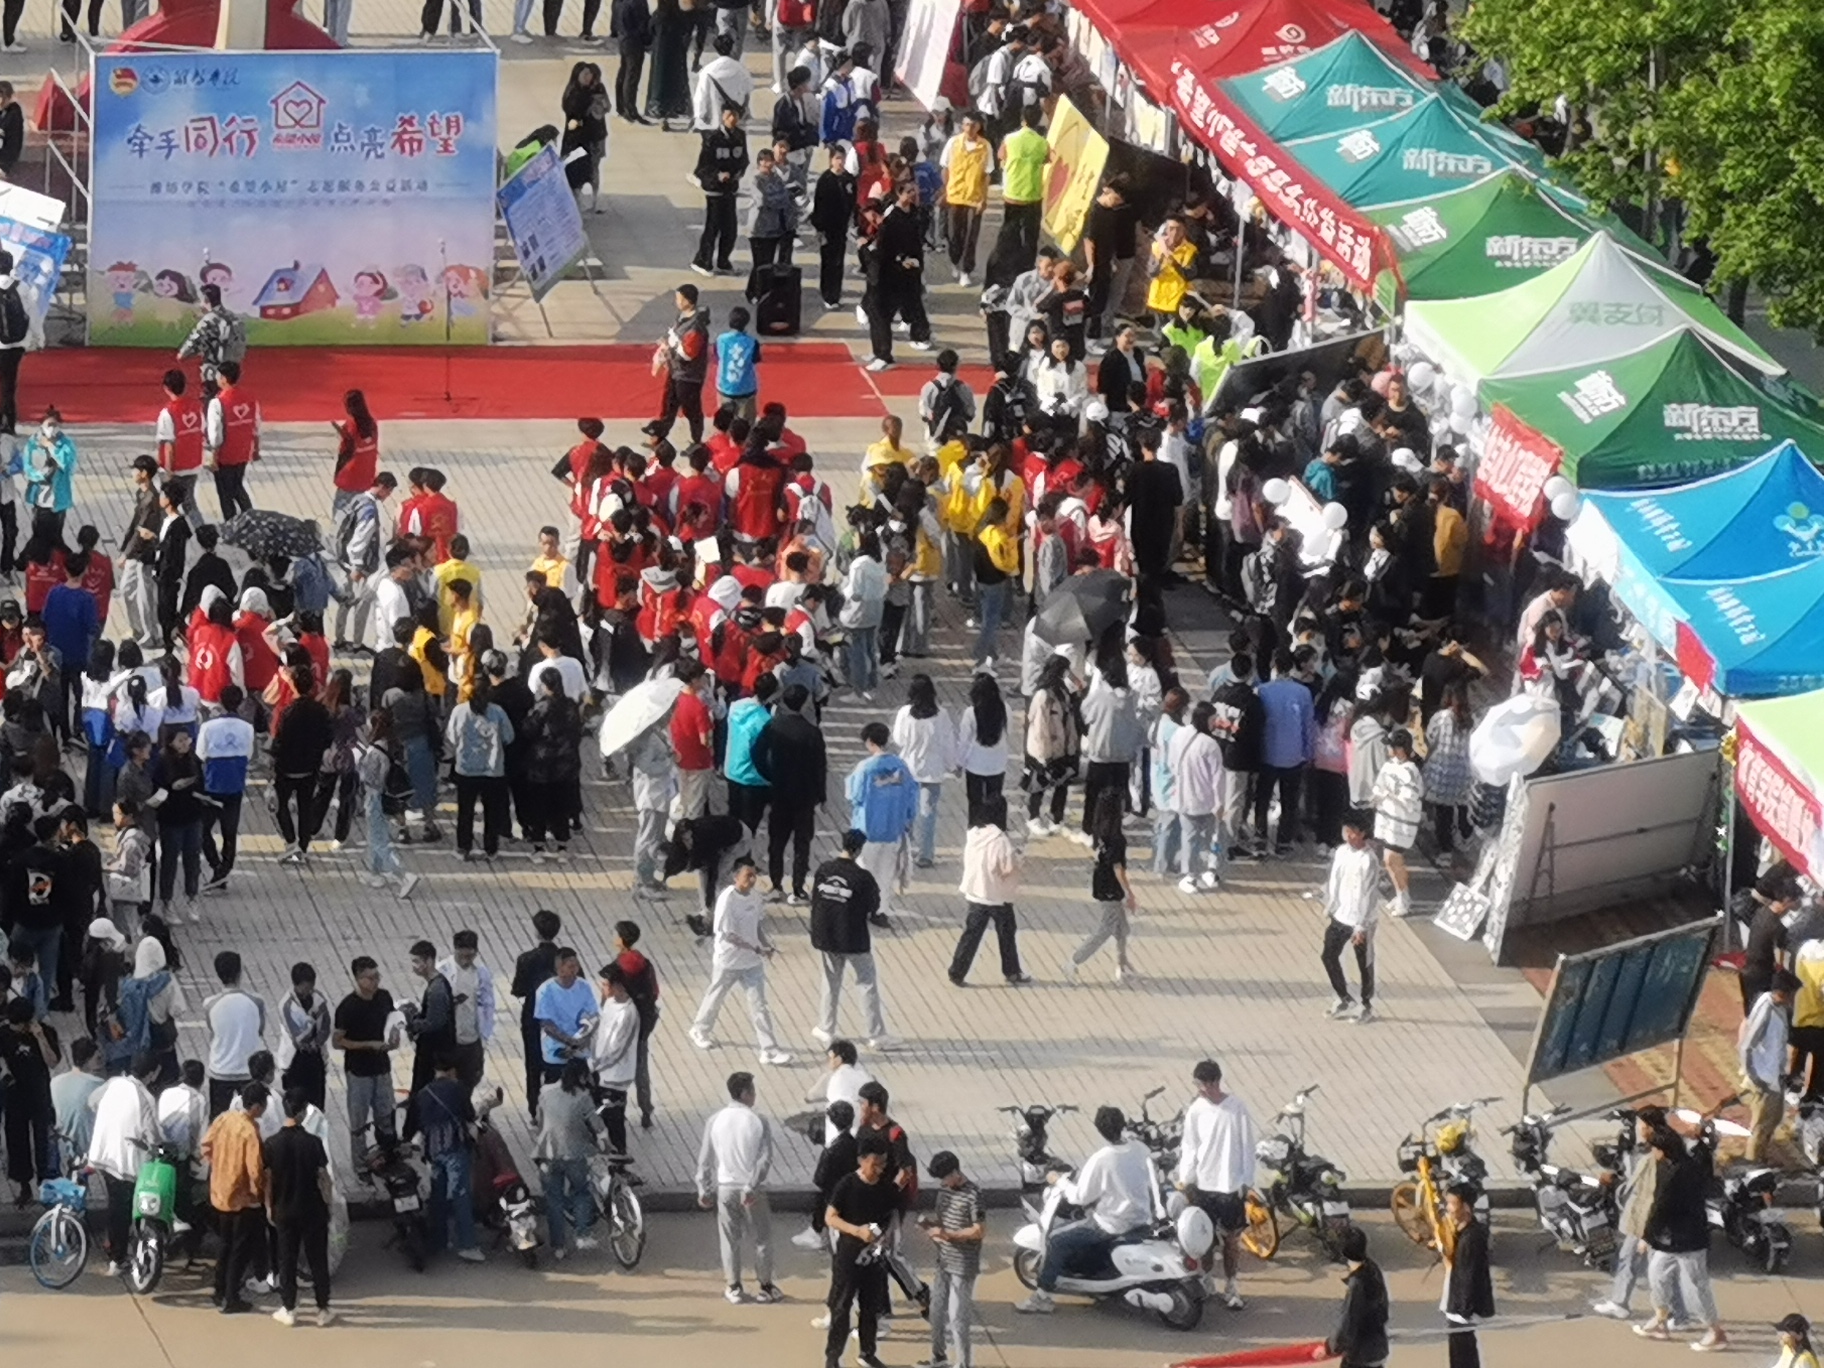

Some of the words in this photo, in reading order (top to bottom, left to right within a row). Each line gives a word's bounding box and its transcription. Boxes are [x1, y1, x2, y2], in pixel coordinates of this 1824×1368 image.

[1327, 84, 1413, 112] 新东方
[125, 114, 261, 160] 牵手同行
[328, 112, 464, 161] 点亮希望
[1402, 148, 1492, 177] 新东方
[1486, 235, 1578, 259] 新东方
[1663, 403, 1760, 433] 新东方
